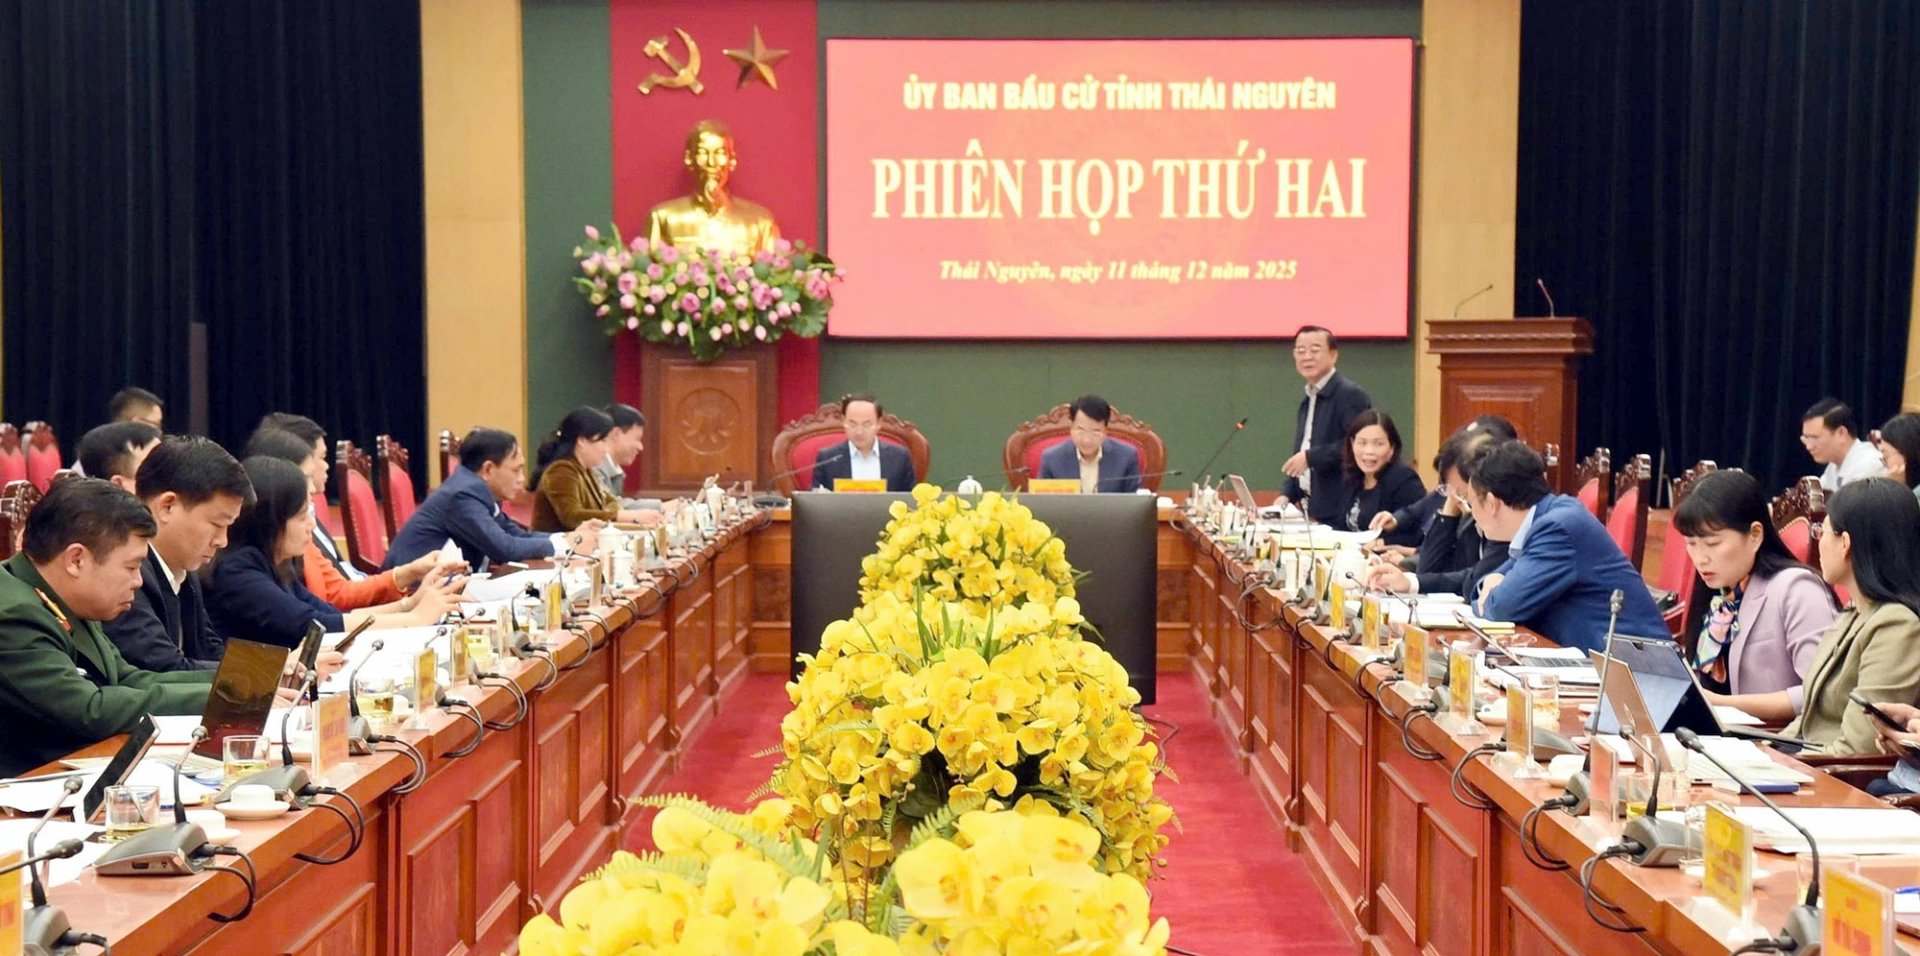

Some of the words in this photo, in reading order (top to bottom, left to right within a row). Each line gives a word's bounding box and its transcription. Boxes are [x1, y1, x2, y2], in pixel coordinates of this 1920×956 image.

[902, 73, 938, 110] ỦY
[942, 81, 998, 111] BAN
[1060, 73, 1102, 111] CỬ
[1101, 73, 1163, 111] TỈNH
[1167, 76, 1227, 111] THÁI
[1231, 76, 1337, 110] NGUYÊN
[870, 137, 1027, 220] PHIÊN
[1037, 157, 1145, 237] HỌP
[1151, 139, 1267, 221] THỨ
[1274, 157, 1368, 219] HAI
[939, 260, 982, 280] Thái
[982, 260, 1057, 285] Nguyên,
[1058, 259, 1105, 285] ngày
[1107, 259, 1128, 281] 11
[1129, 259, 1183, 285] tháng
[1185, 259, 1209, 281] 12
[1209, 260, 1251, 281] năm
[1253, 259, 1298, 280] 2025
